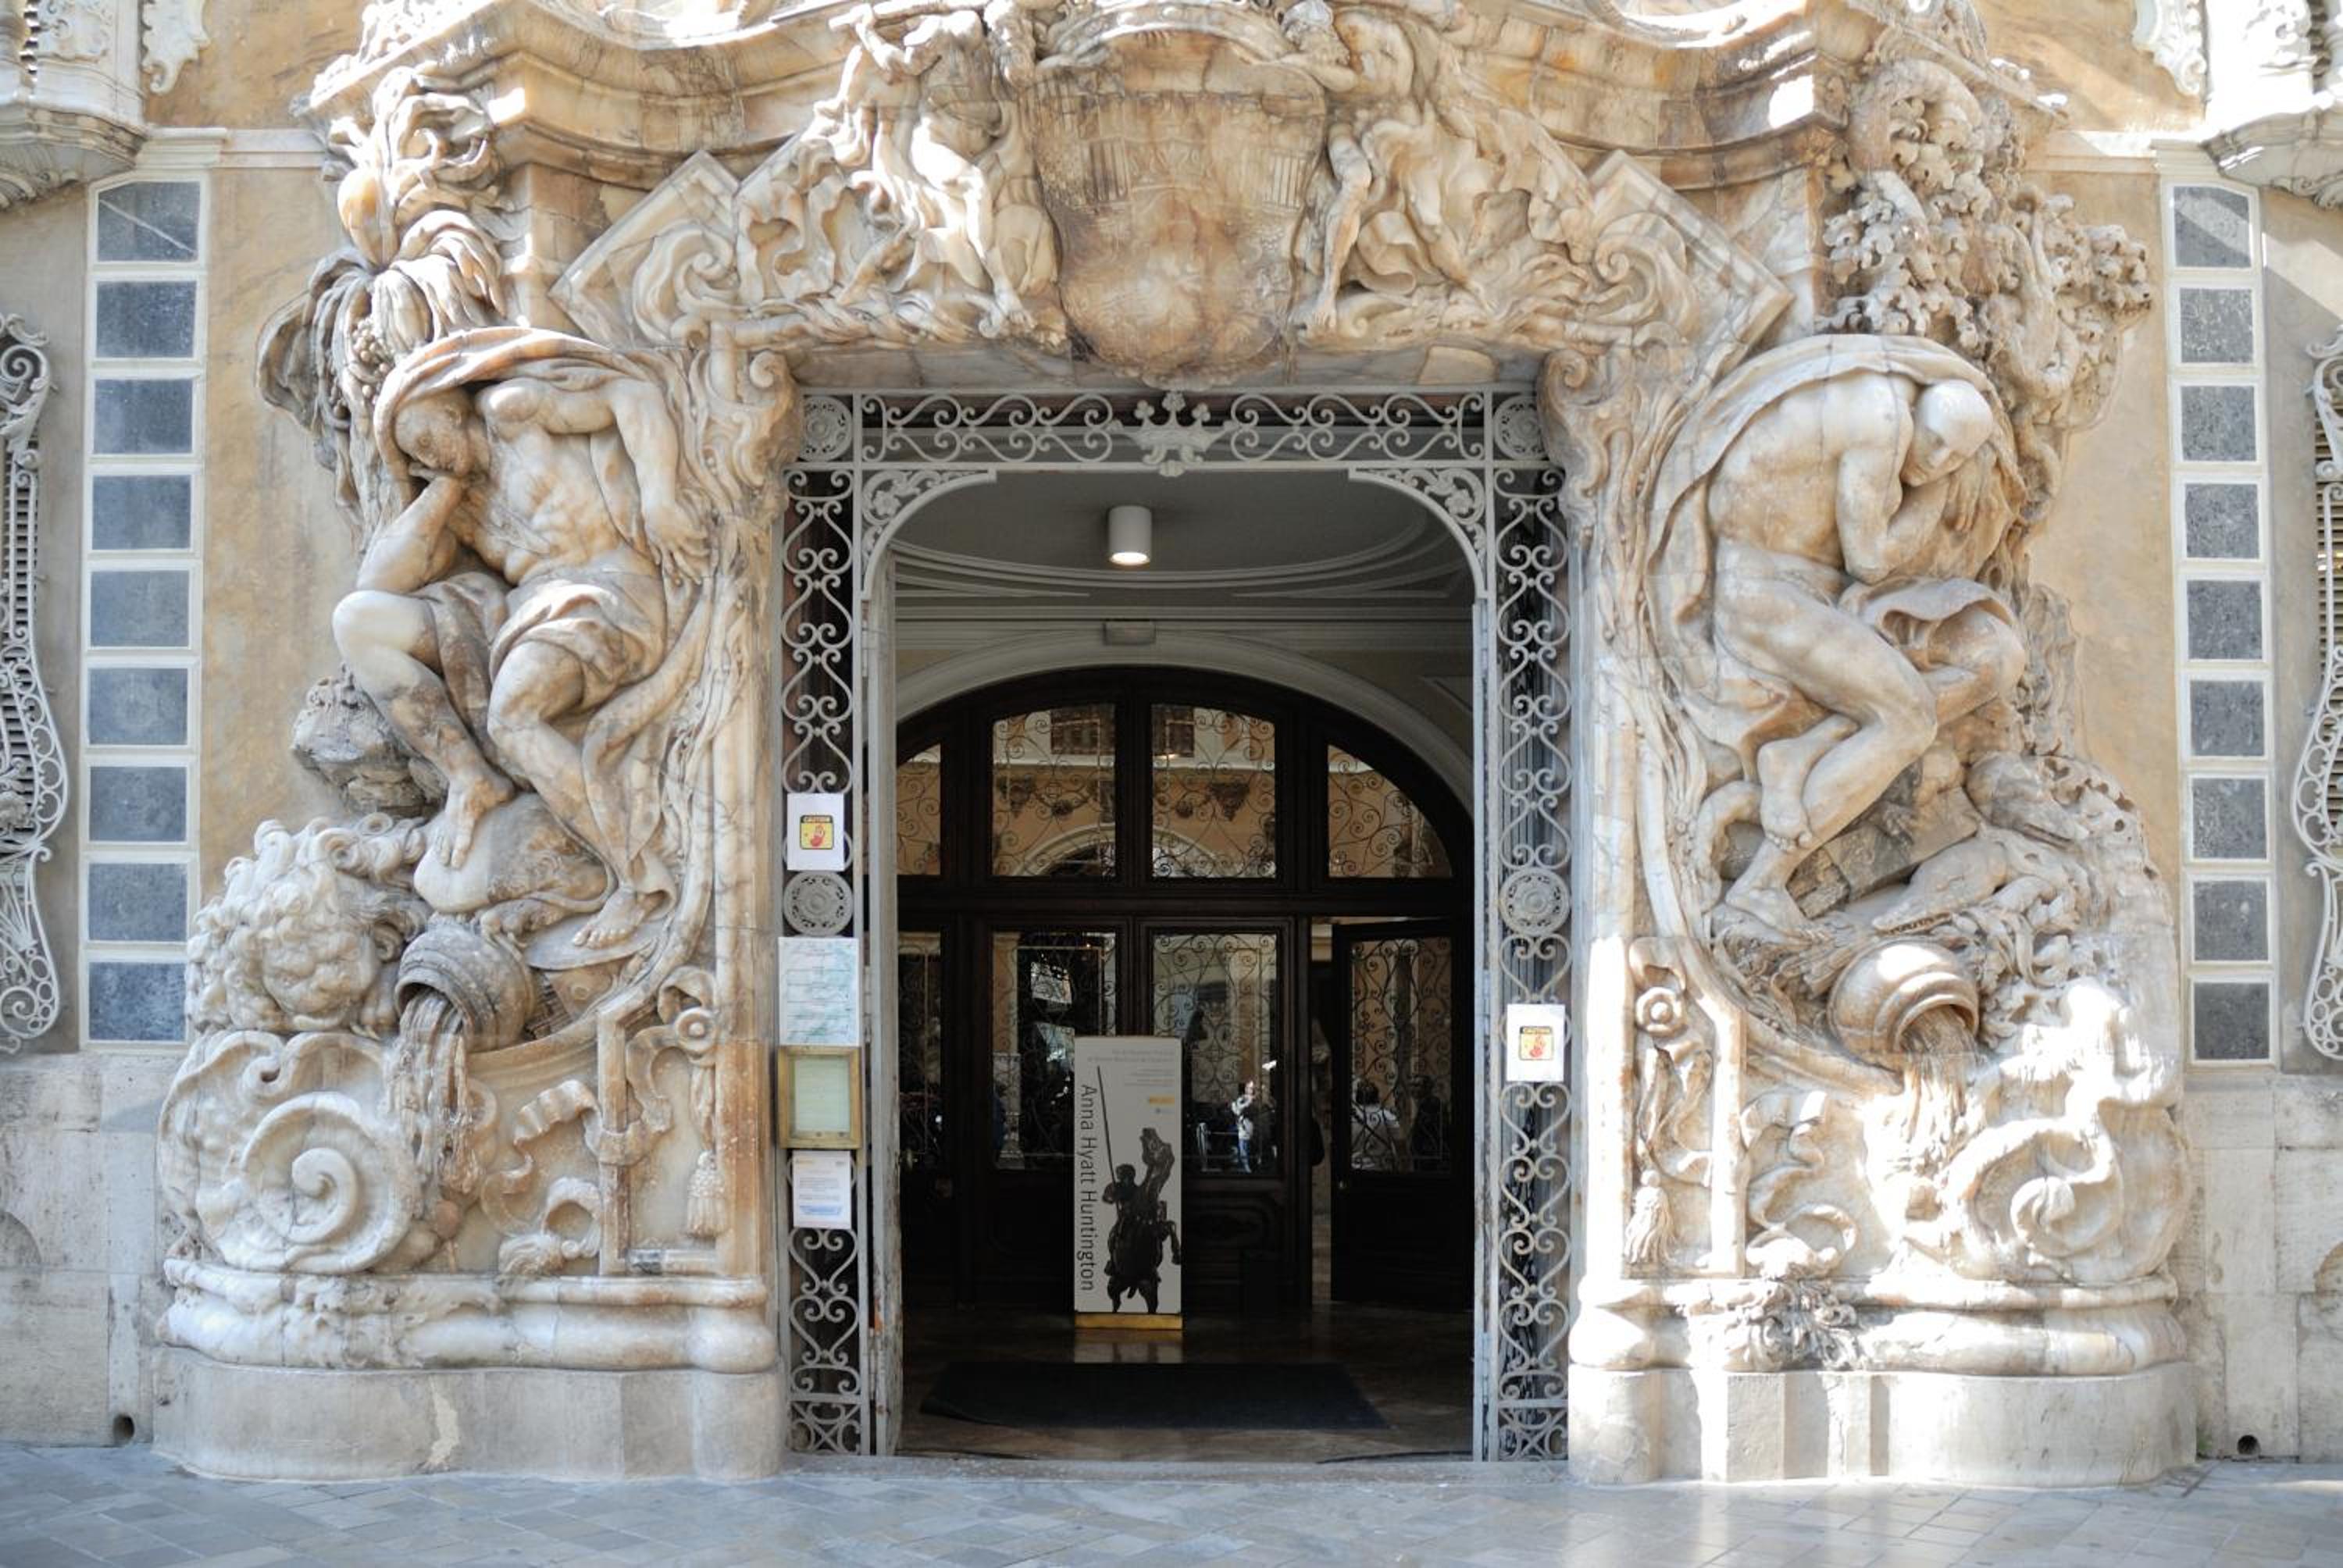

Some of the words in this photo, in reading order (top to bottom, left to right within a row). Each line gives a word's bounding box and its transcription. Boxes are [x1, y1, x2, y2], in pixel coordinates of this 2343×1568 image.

[1080, 1085, 1097, 1130] Anna
[1076, 1138, 1097, 1184] Hyatt
[1076, 1191, 1098, 1291] Huntington
